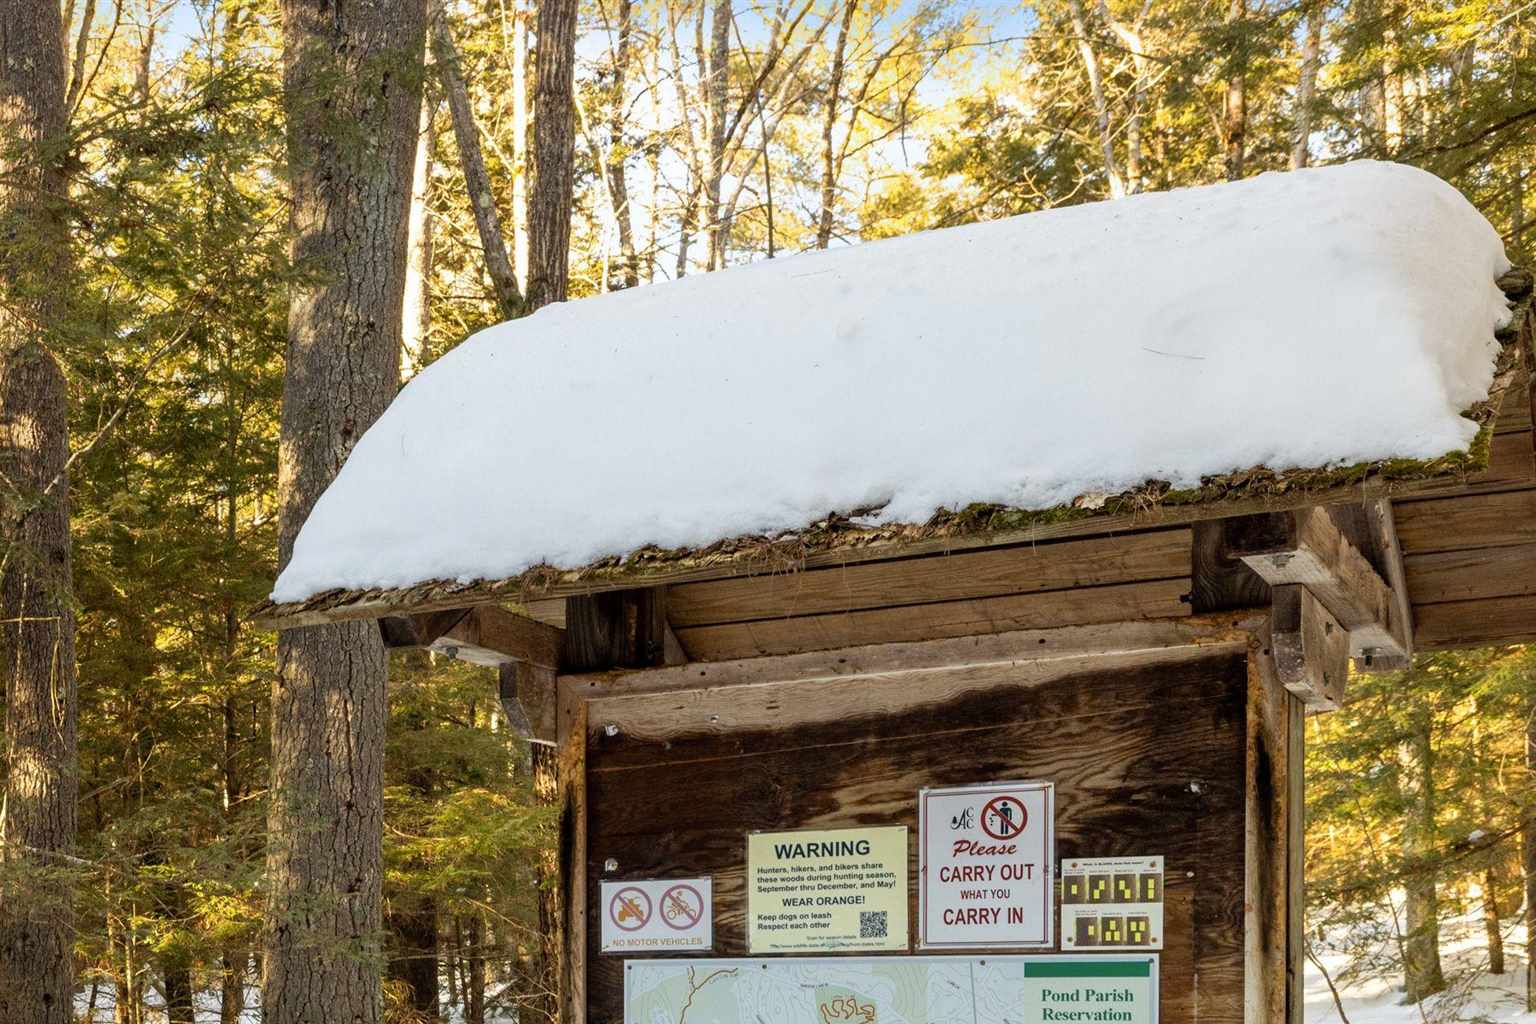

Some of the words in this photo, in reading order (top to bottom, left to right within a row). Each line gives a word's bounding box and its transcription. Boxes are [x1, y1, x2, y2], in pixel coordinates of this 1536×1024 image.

[774, 840, 870, 860] WARNING
[953, 839, 1017, 858] Please
[757, 867, 788, 875] Hunters,
[791, 865, 816, 873] hikers,
[819, 864, 833, 872] and
[835, 863, 859, 871] bikers
[861, 862, 883, 870] share
[940, 865, 996, 883] CARRY
[1000, 863, 1034, 881] OUT
[780, 874, 805, 882] woods
[807, 873, 831, 883] during
[833, 872, 864, 882] hunting
[757, 885, 798, 894] September
[800, 884, 815, 892] thru
[817, 882, 858, 891] December,
[860, 881, 875, 889] and
[877, 880, 896, 890] May!
[960, 889, 988, 900] WHAT
[990, 888, 1011, 899] YOU
[782, 897, 813, 907] WEAR
[816, 895, 865, 906] ORANGE!
[757, 914, 777, 923] Keep
[779, 912, 798, 922] dogs
[811, 912, 832, 920] leash
[943, 907, 1001, 925] CARRY
[1007, 907, 1023, 924] IN
[757, 923, 788, 931] Respect
[613, 938, 625, 946] NO
[628, 937, 659, 946] MOTOR
[660, 936, 703, 945] VEHICLES
[1041, 988, 1080, 1002] Pond
[1085, 988, 1134, 1002] Parish
[1042, 1008, 1132, 1021] Reservation
